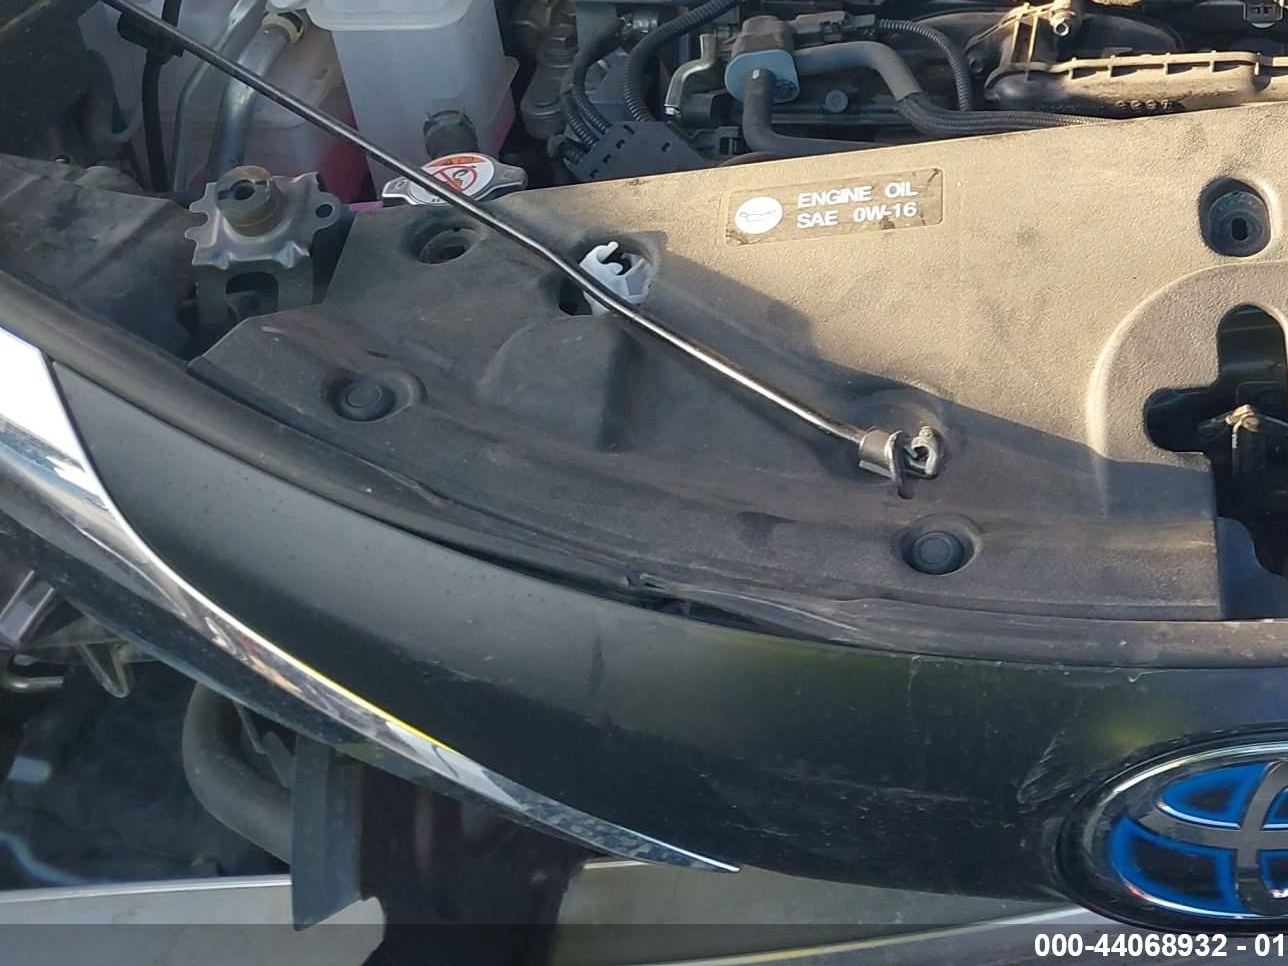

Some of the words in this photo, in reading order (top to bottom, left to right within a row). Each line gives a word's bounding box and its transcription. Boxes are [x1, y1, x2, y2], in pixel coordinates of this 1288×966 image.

[798, 186, 871, 207] ENGINE
[885, 181, 918, 198] OIL
[797, 209, 839, 229] SAE
[853, 201, 917, 223] 0W-16
